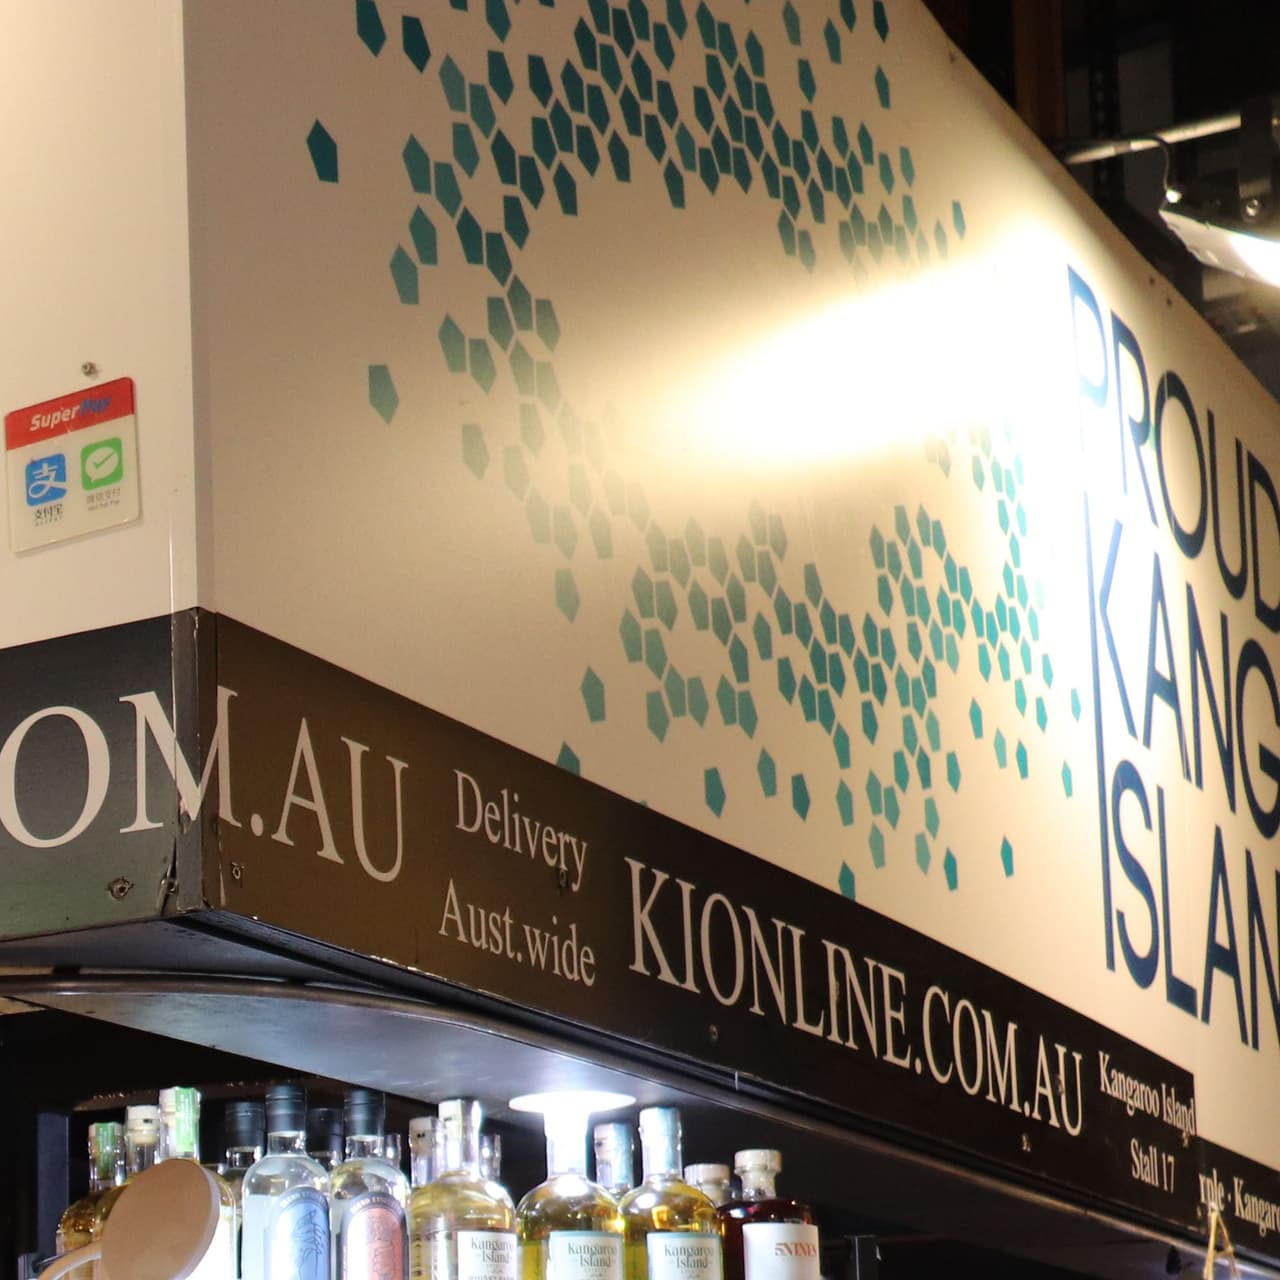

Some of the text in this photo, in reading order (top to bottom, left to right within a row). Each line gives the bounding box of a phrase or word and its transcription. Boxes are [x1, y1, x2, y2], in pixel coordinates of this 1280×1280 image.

[454, 768, 588, 894] Delivery
[439, 878, 598, 988] Aust.wide
[624, 856, 1083, 1137] KIONLINE.COM.AU
[1098, 1050, 1197, 1137] Kangaroo Island
[1131, 1137, 1176, 1195] Stall 17
[481, 1250, 510, 1264] Island
[568, 1243, 617, 1257] Kangaroo
[579, 1255, 613, 1269] Island
[664, 1244, 715, 1258] Kangaroo
[676, 1256, 709, 1270] Island
